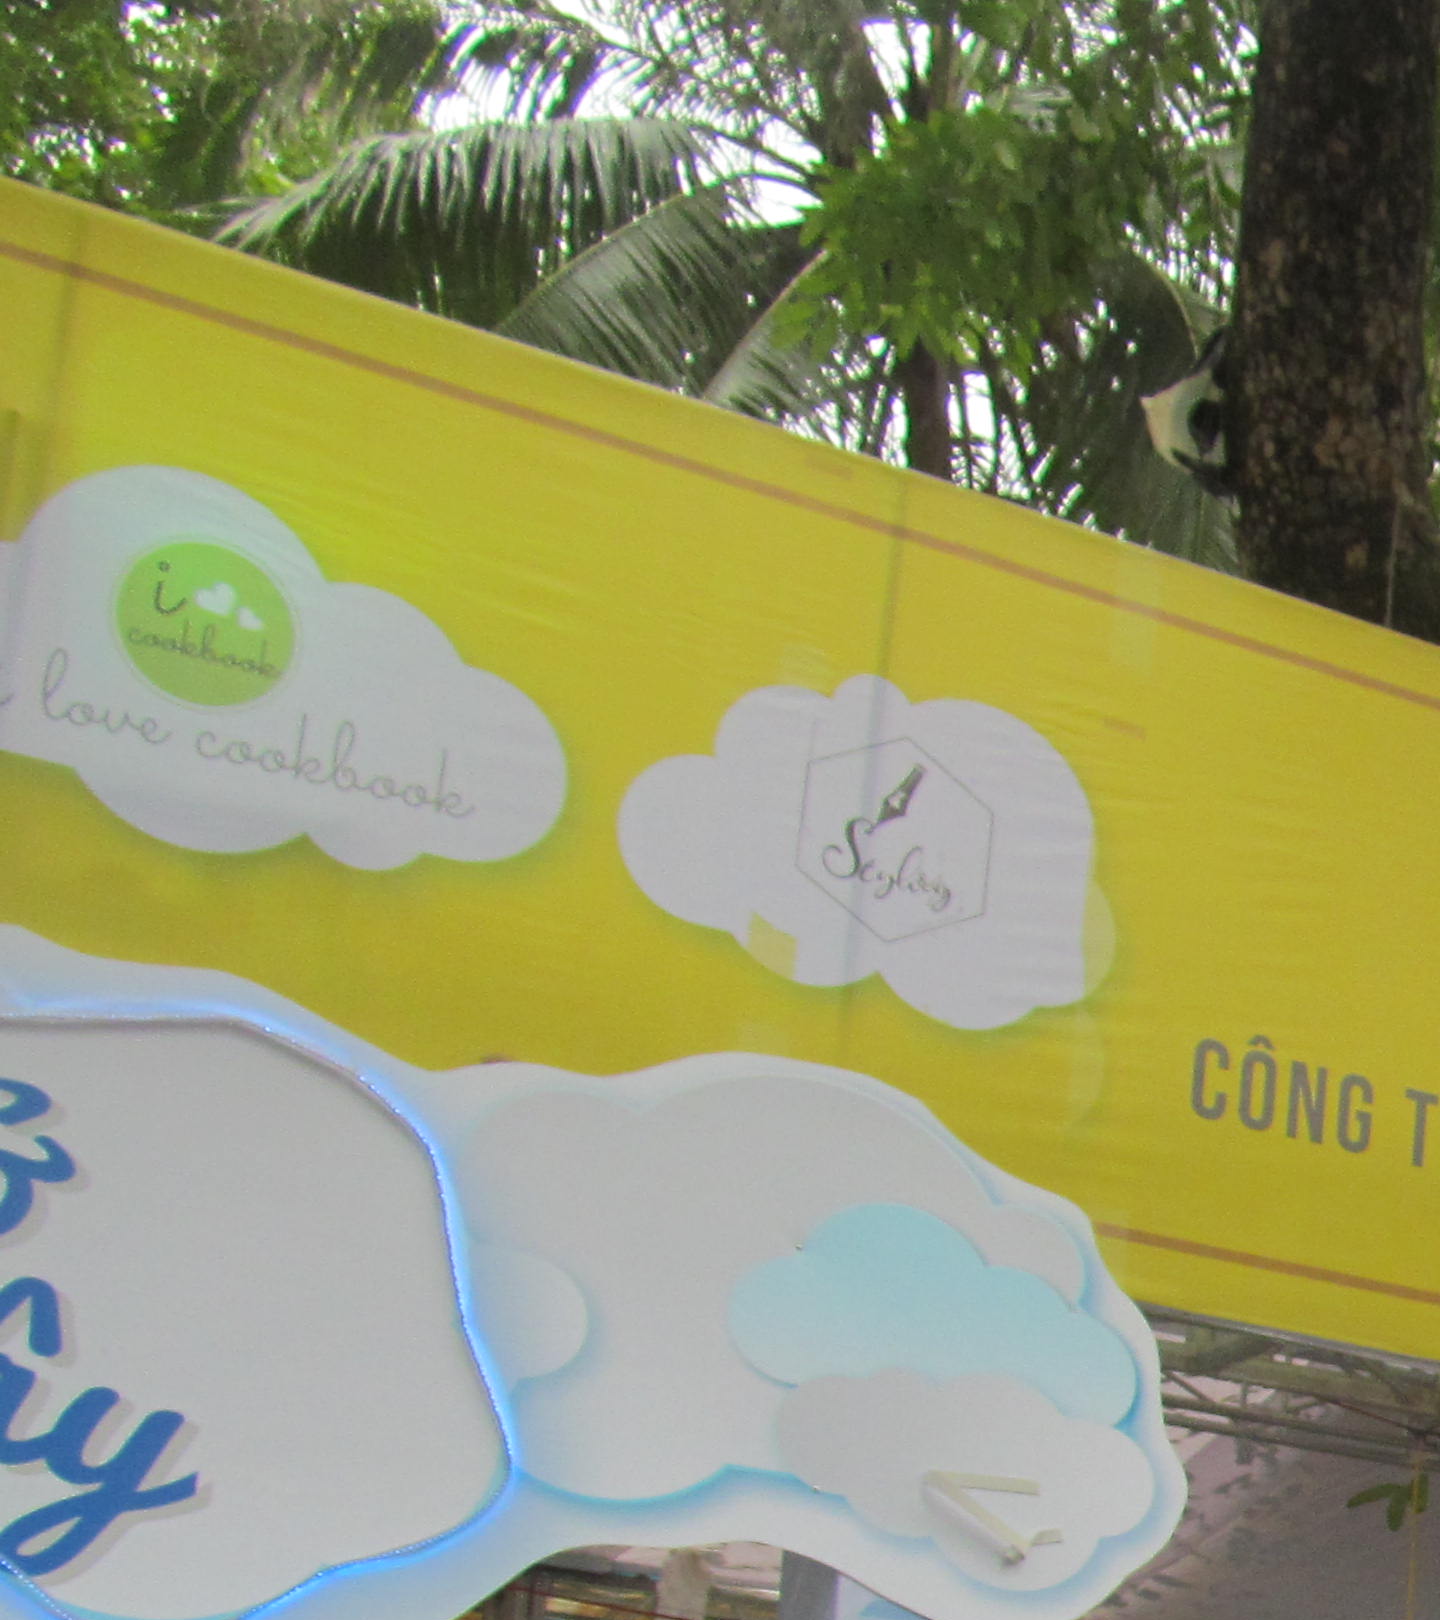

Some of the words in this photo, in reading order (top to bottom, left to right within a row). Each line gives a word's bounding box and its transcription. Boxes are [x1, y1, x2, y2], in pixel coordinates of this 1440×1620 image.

[127, 618, 284, 680] cookbook
[41, 647, 174, 745] love
[195, 713, 476, 819] cookbook
[1189, 1033, 1374, 1154] CÔNG
